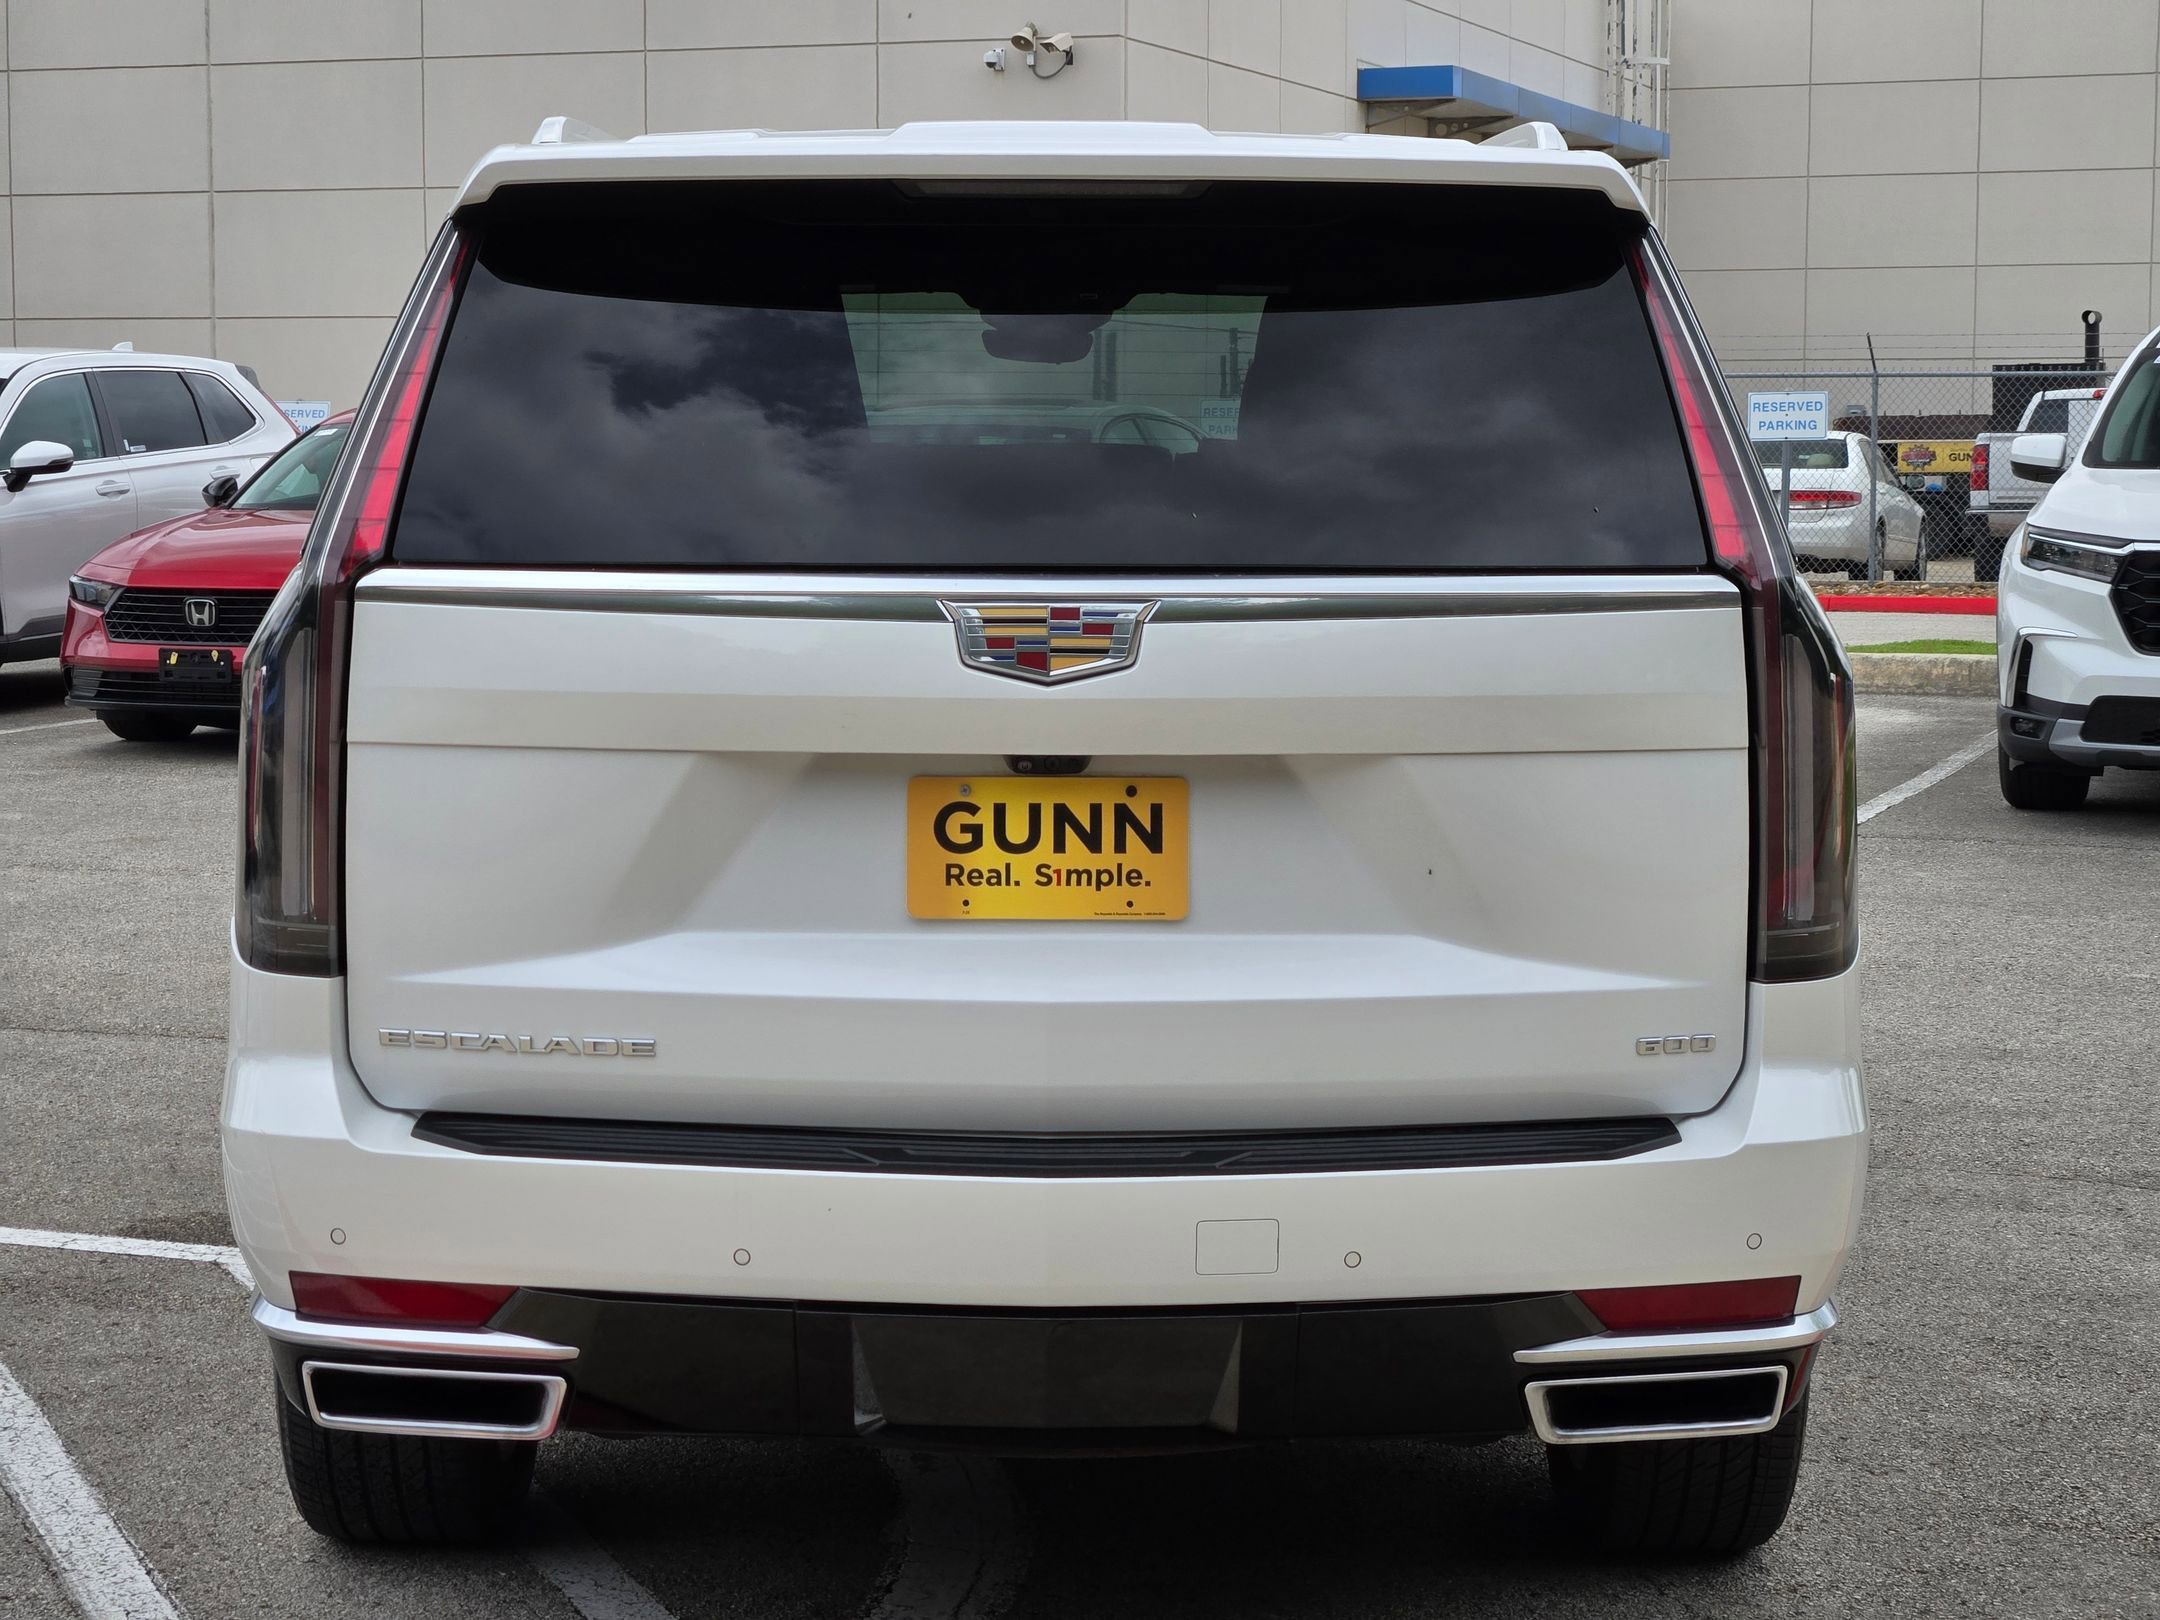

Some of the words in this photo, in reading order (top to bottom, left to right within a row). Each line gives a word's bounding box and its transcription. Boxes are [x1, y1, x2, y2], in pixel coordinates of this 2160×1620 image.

[1753, 401, 1823, 412] RESERVED
[1759, 420, 1817, 430] PARKING
[933, 801, 1163, 854] GUNN
[945, 863, 1020, 887] Real.
[1034, 863, 1151, 891] S1mple.
[378, 1027, 656, 1057] ESCALADE
[1636, 1034, 1716, 1056] 600
